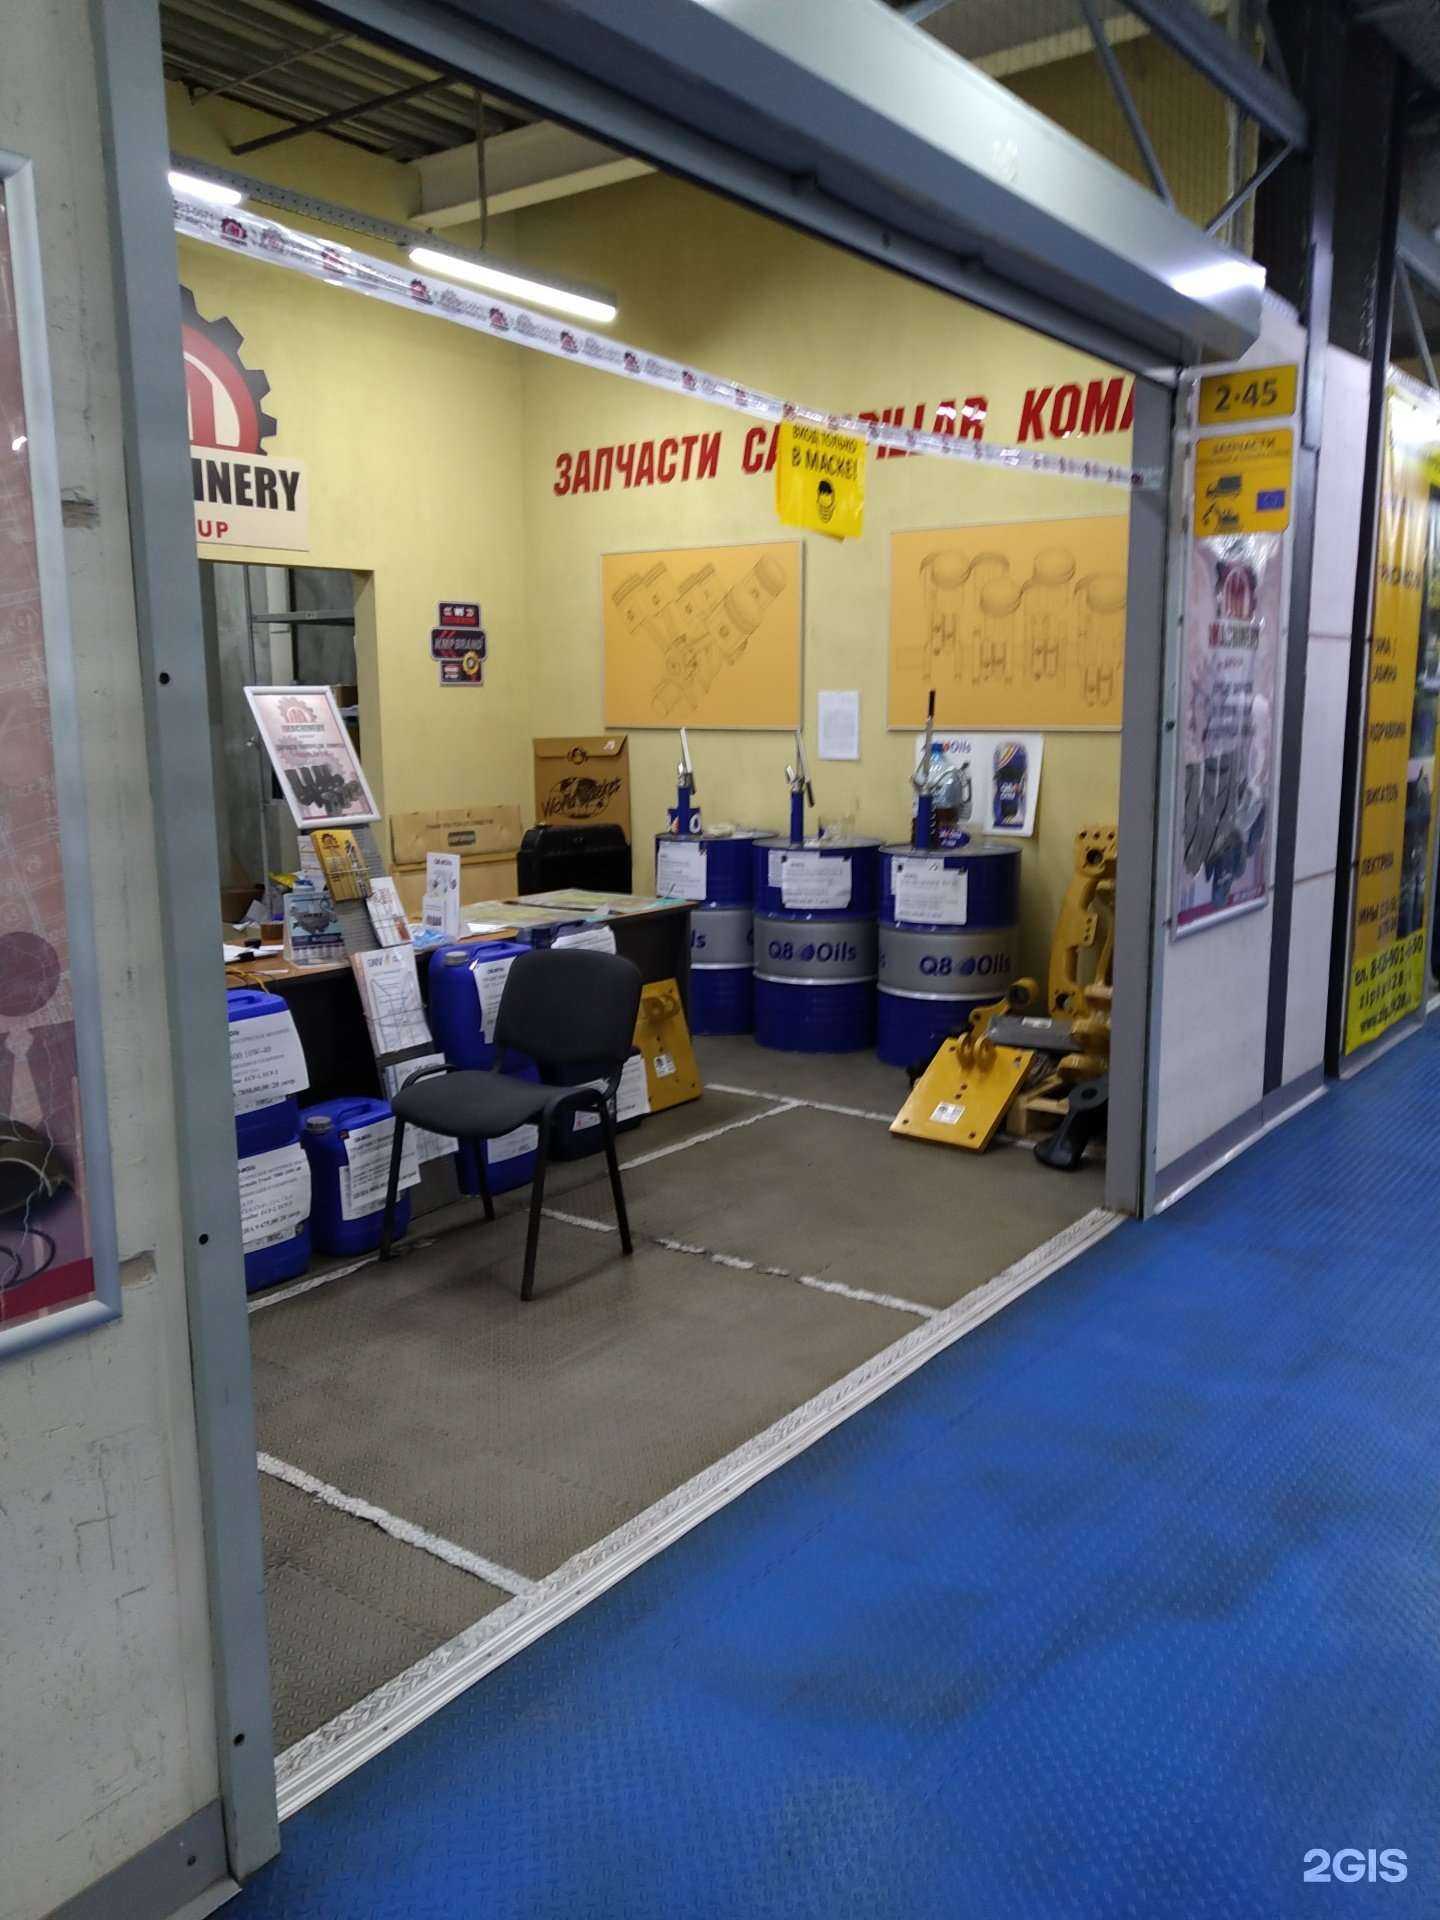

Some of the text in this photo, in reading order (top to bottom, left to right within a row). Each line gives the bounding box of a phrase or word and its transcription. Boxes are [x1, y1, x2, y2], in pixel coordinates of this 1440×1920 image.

[553, 431, 722, 496] ЗАПЧАСТИ
[792, 446, 802, 467] В
[197, 519, 229, 538] UP
[768, 940, 857, 962] Q8 Oils
[919, 955, 953, 976] Q8
